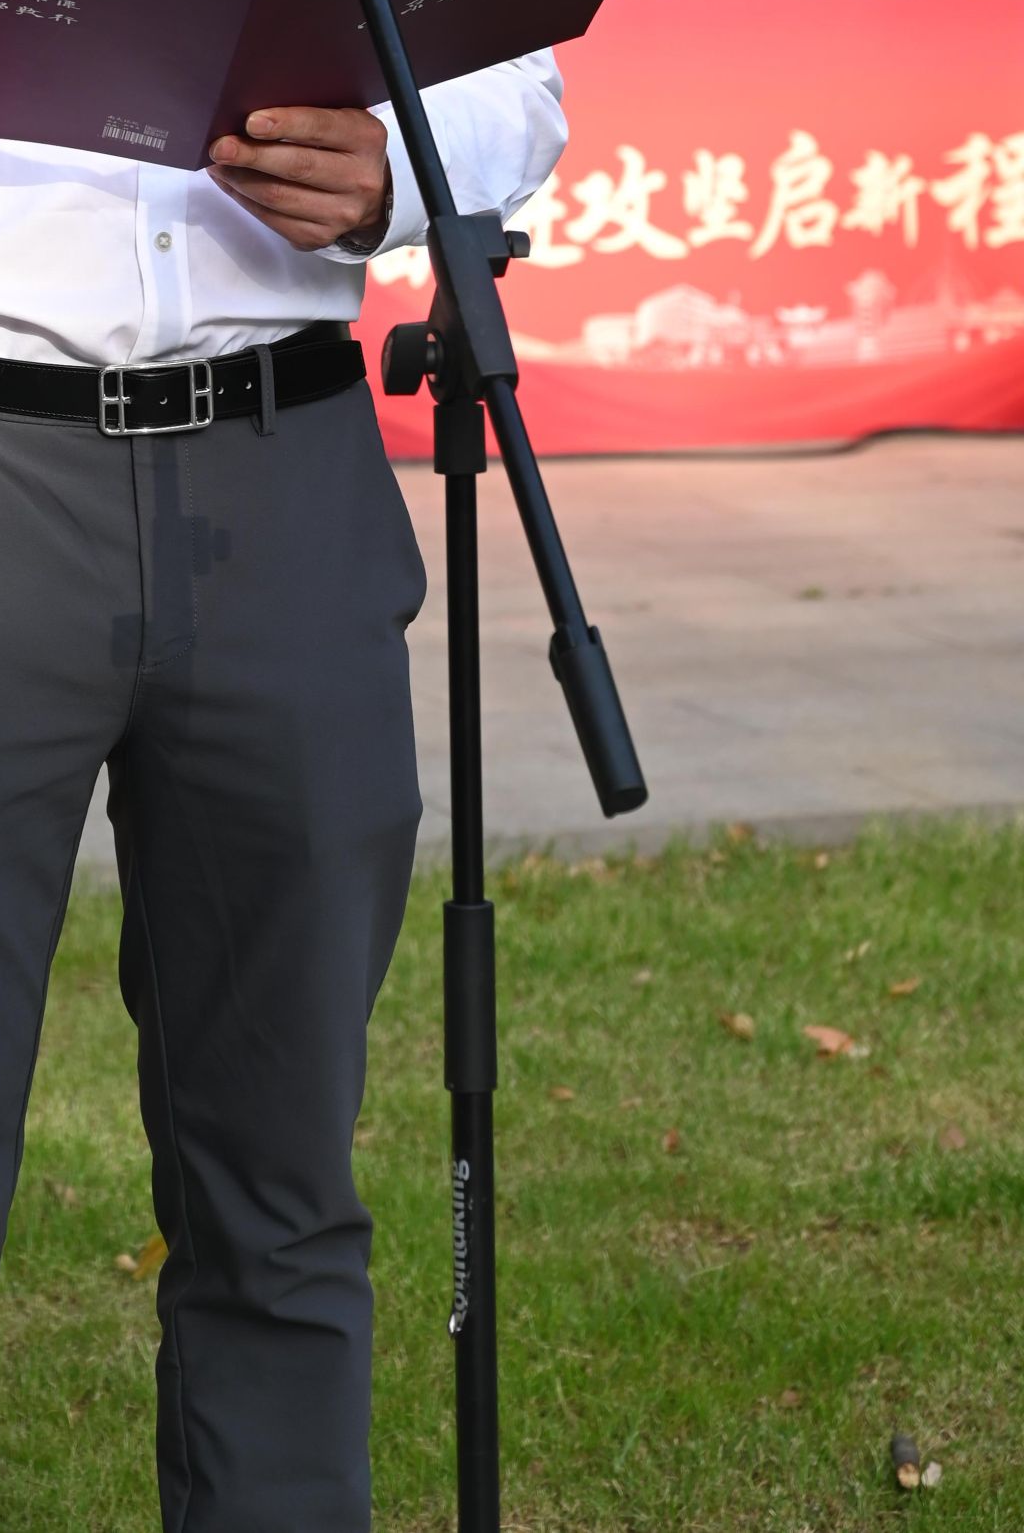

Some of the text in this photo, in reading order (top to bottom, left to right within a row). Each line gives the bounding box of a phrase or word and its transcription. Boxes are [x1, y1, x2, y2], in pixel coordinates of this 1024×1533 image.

[369, 129, 1024, 288] 进攻坚启新程
